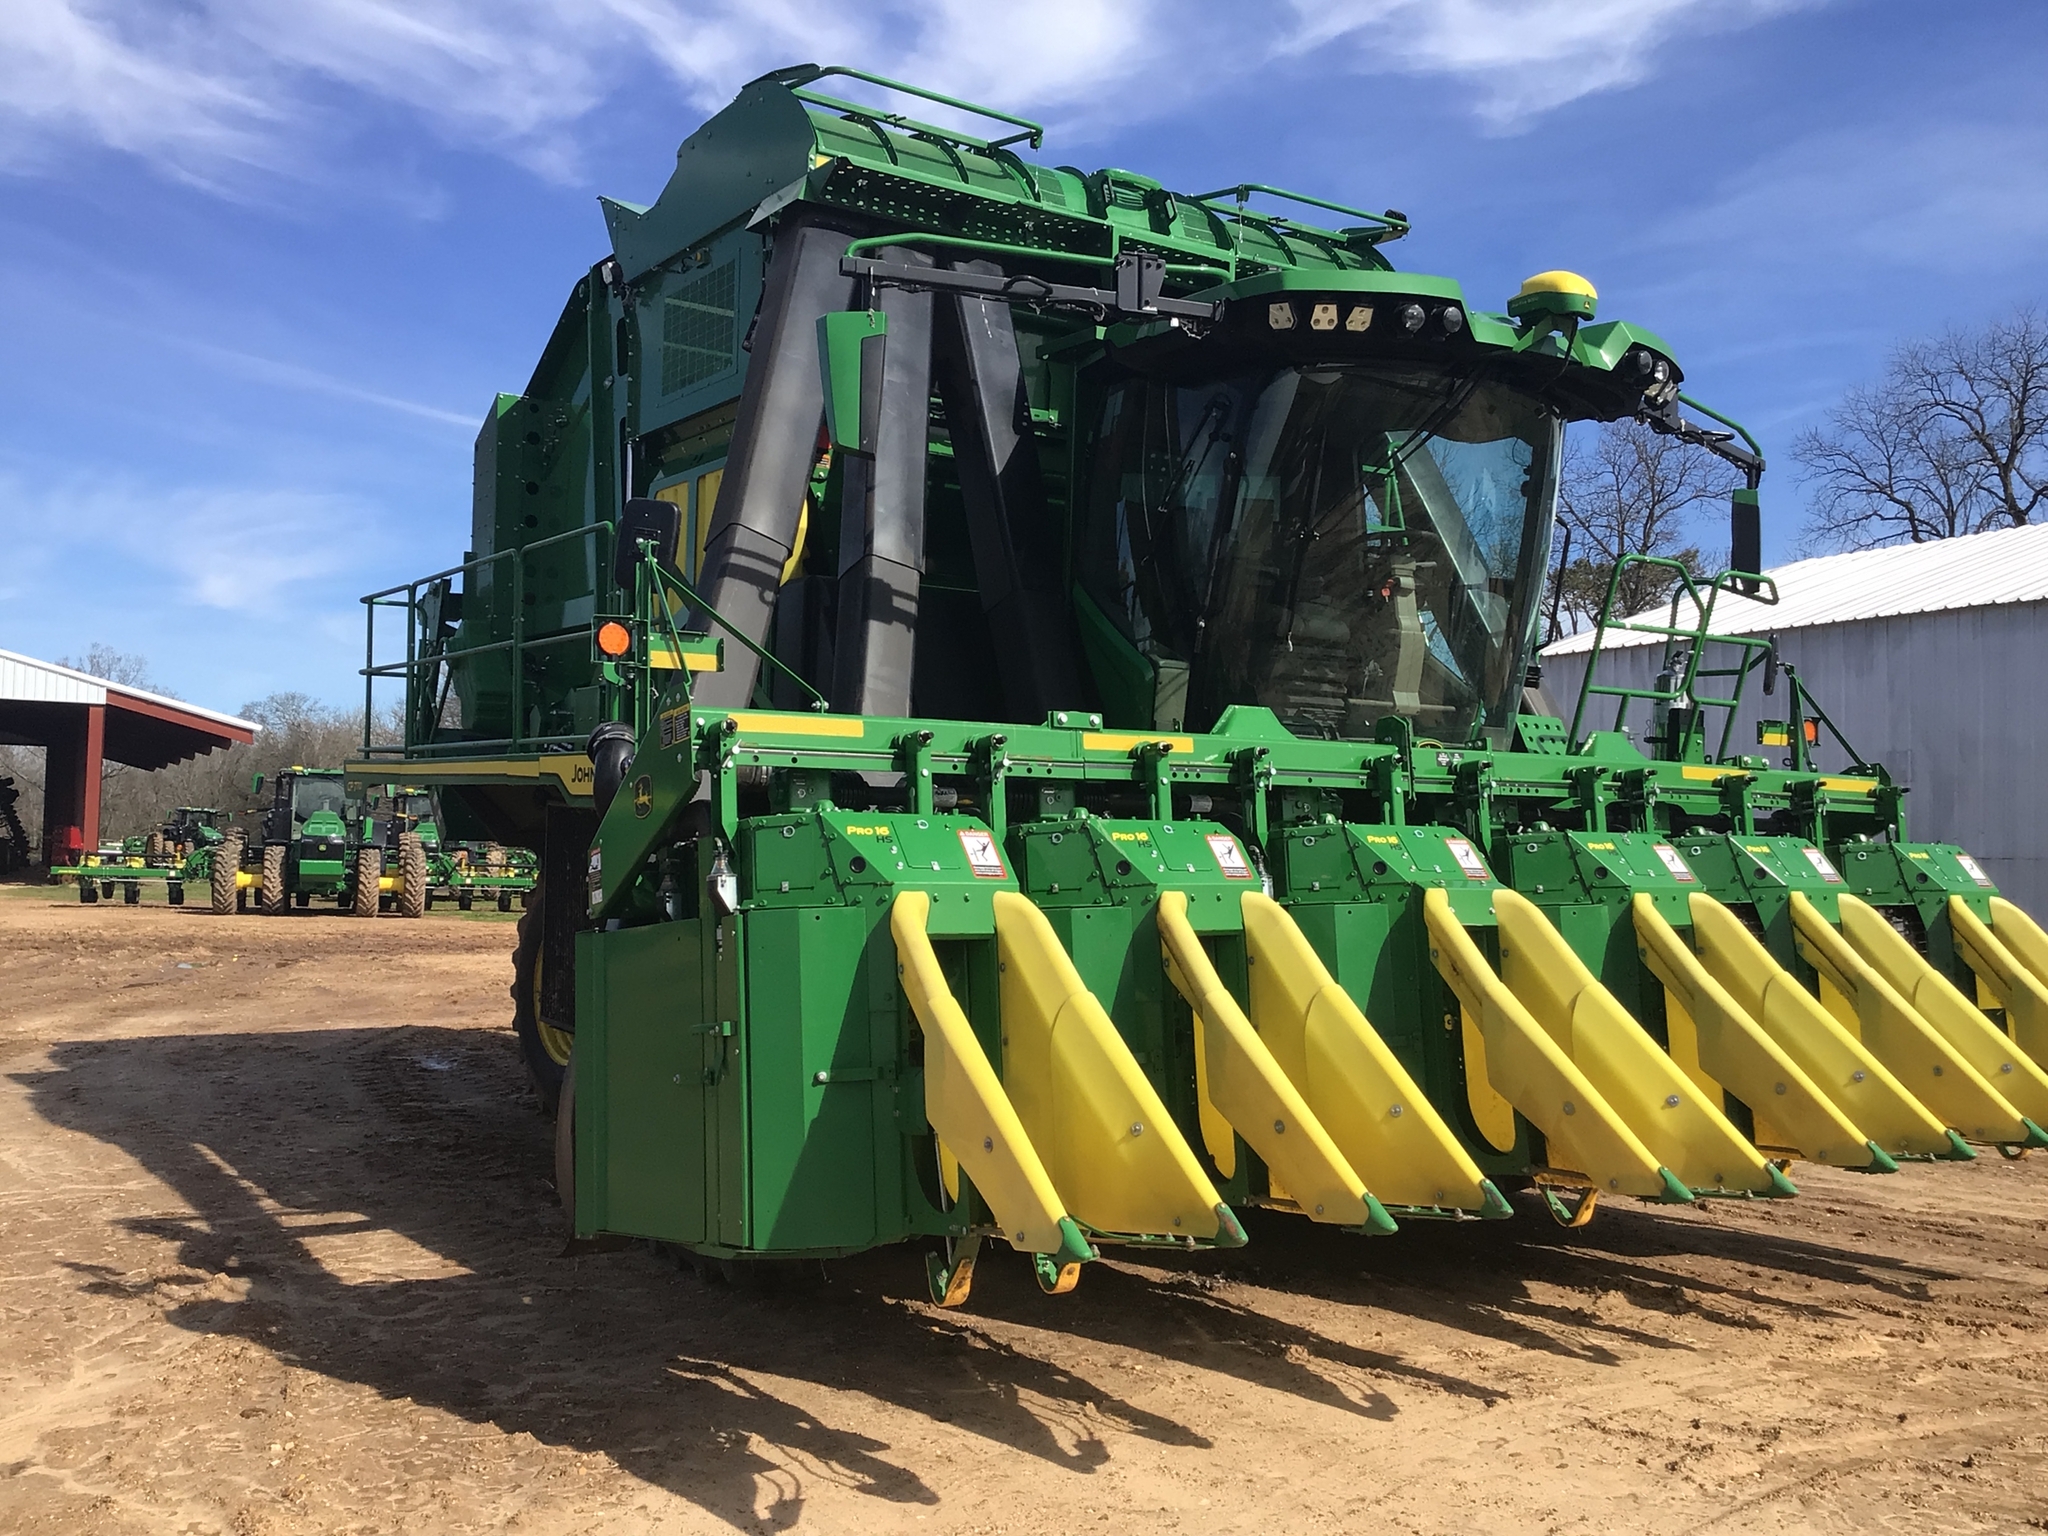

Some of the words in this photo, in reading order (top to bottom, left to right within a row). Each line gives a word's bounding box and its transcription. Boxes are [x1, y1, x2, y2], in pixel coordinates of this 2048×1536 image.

[874, 826, 890, 836] 16
[876, 835, 893, 843] HS
[1134, 832, 1149, 841] 16
[1386, 836, 1399, 845] 16
[1137, 840, 1153, 848] HS
